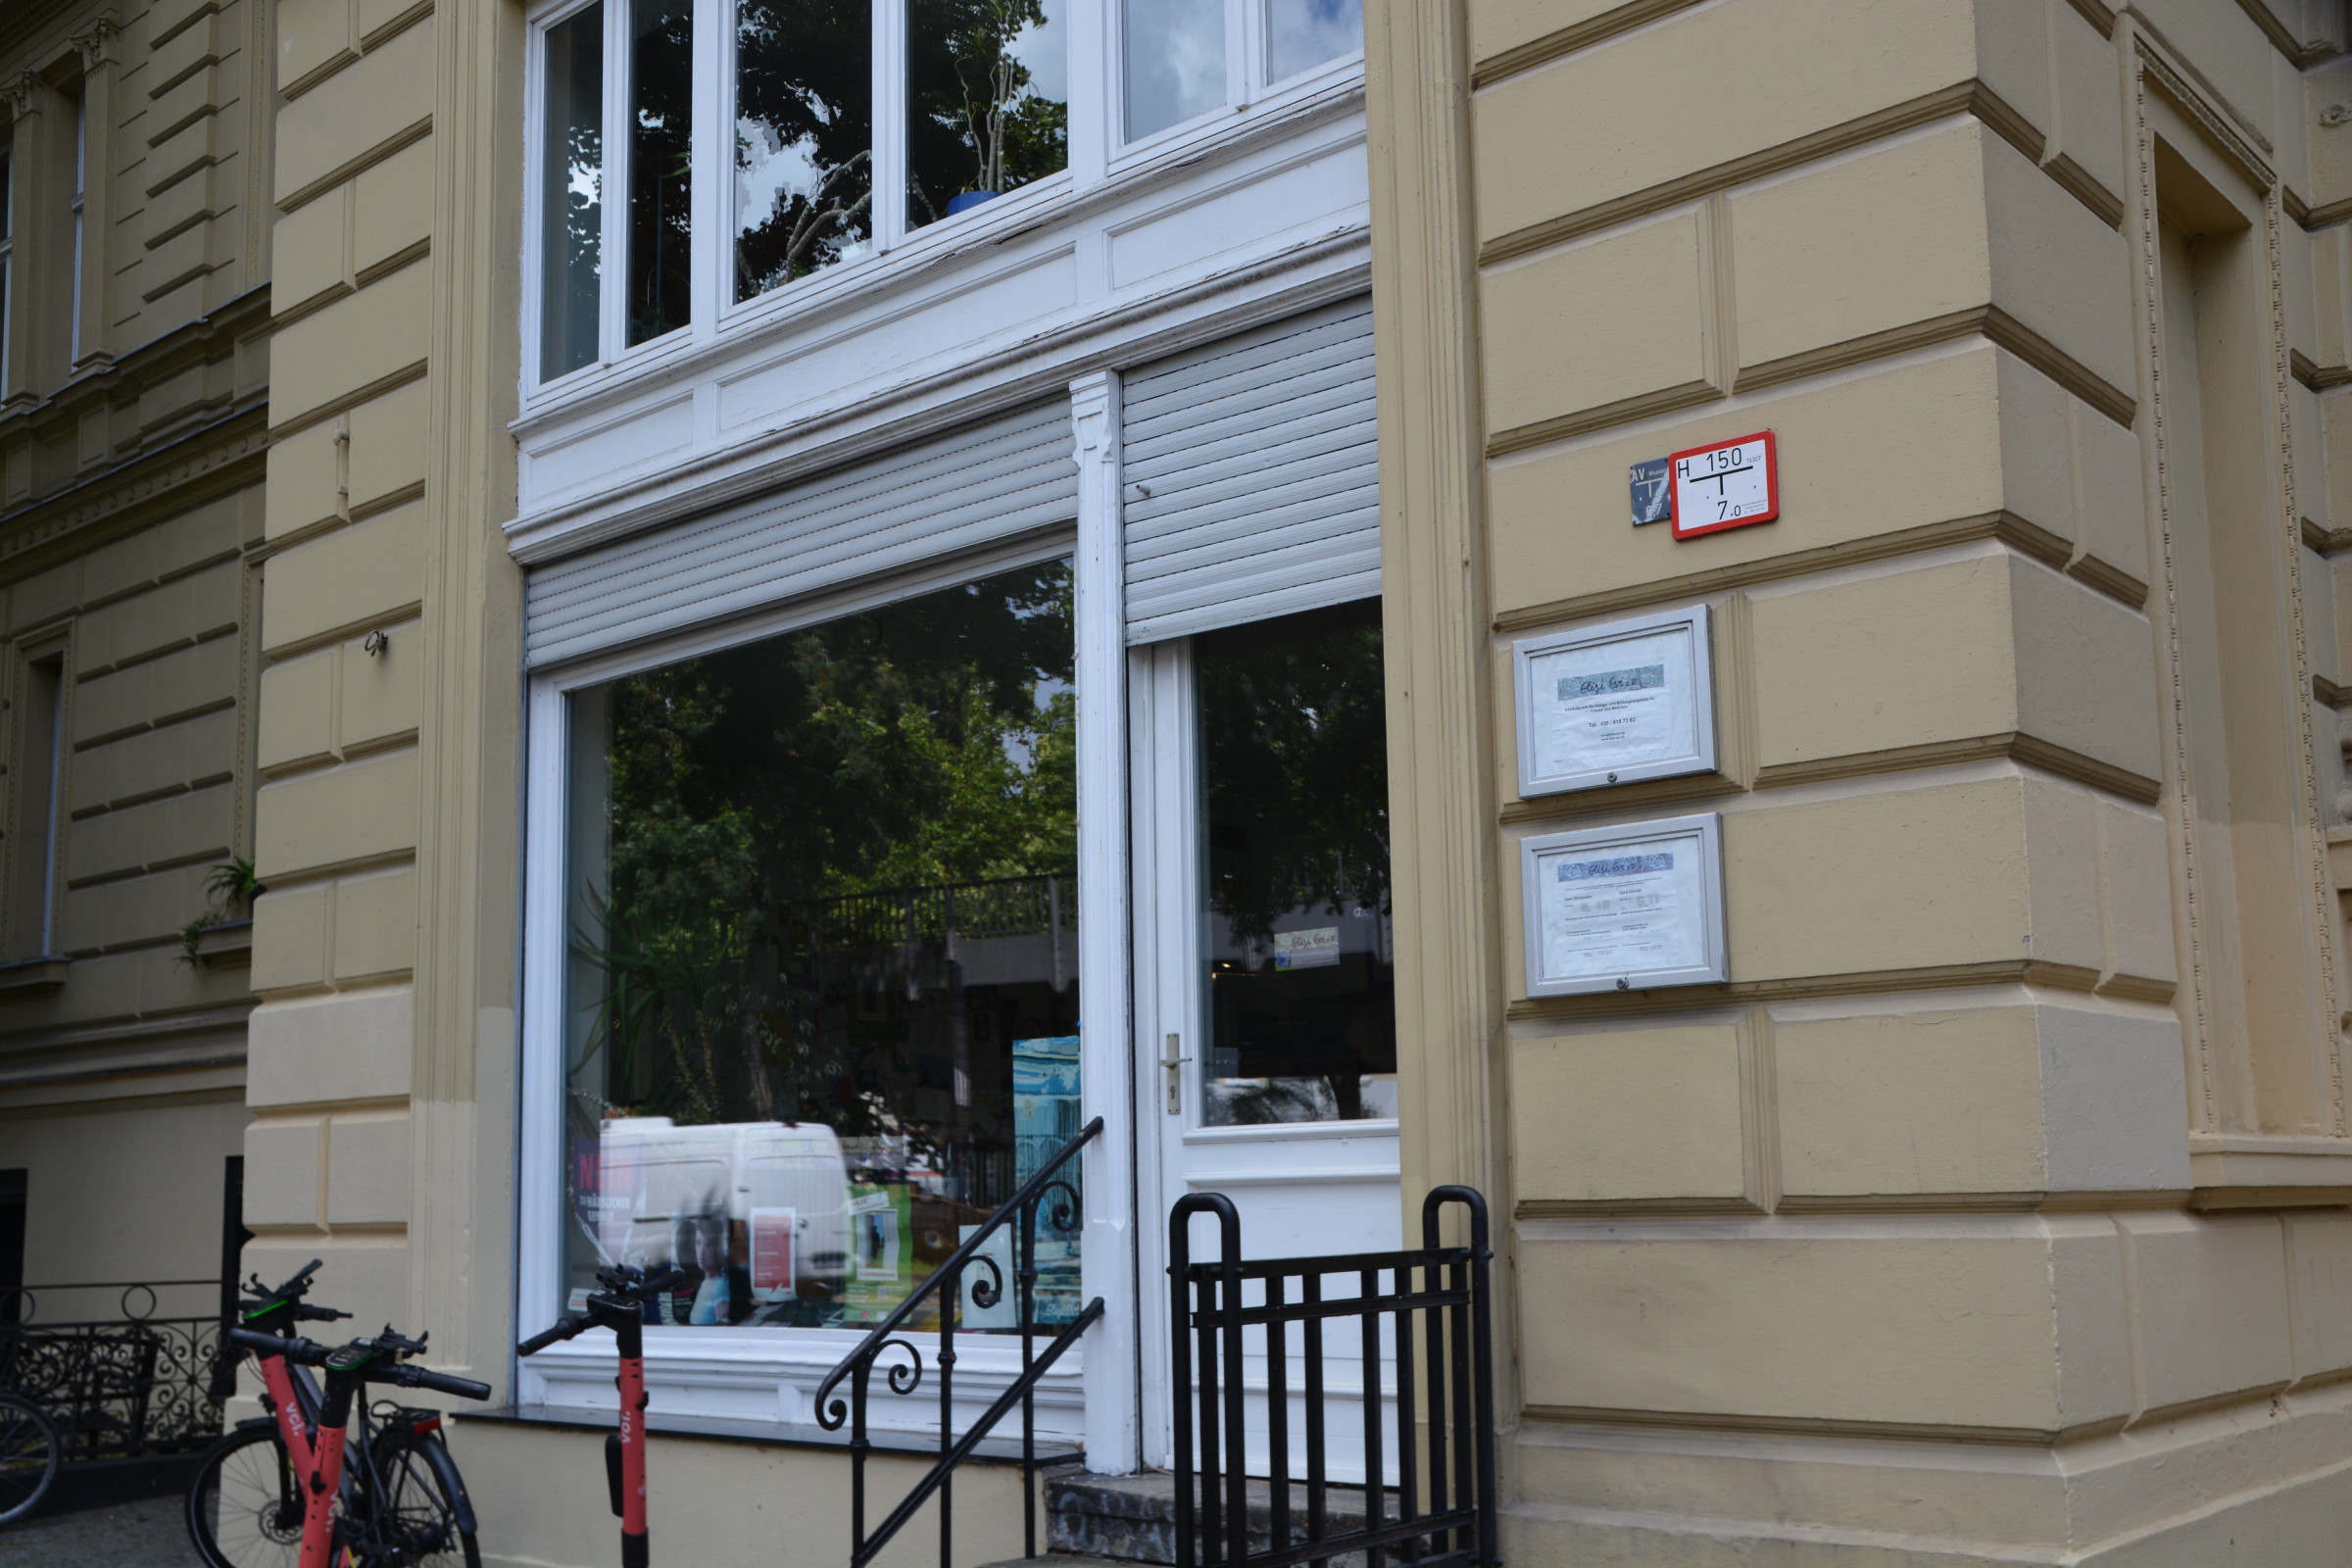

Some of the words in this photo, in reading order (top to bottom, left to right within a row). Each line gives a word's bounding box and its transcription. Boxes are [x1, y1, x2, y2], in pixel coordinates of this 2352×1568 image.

[1678, 460, 1690, 479] H
[1706, 447, 1742, 472] 150
[579, 1152, 632, 1191] NEIN
